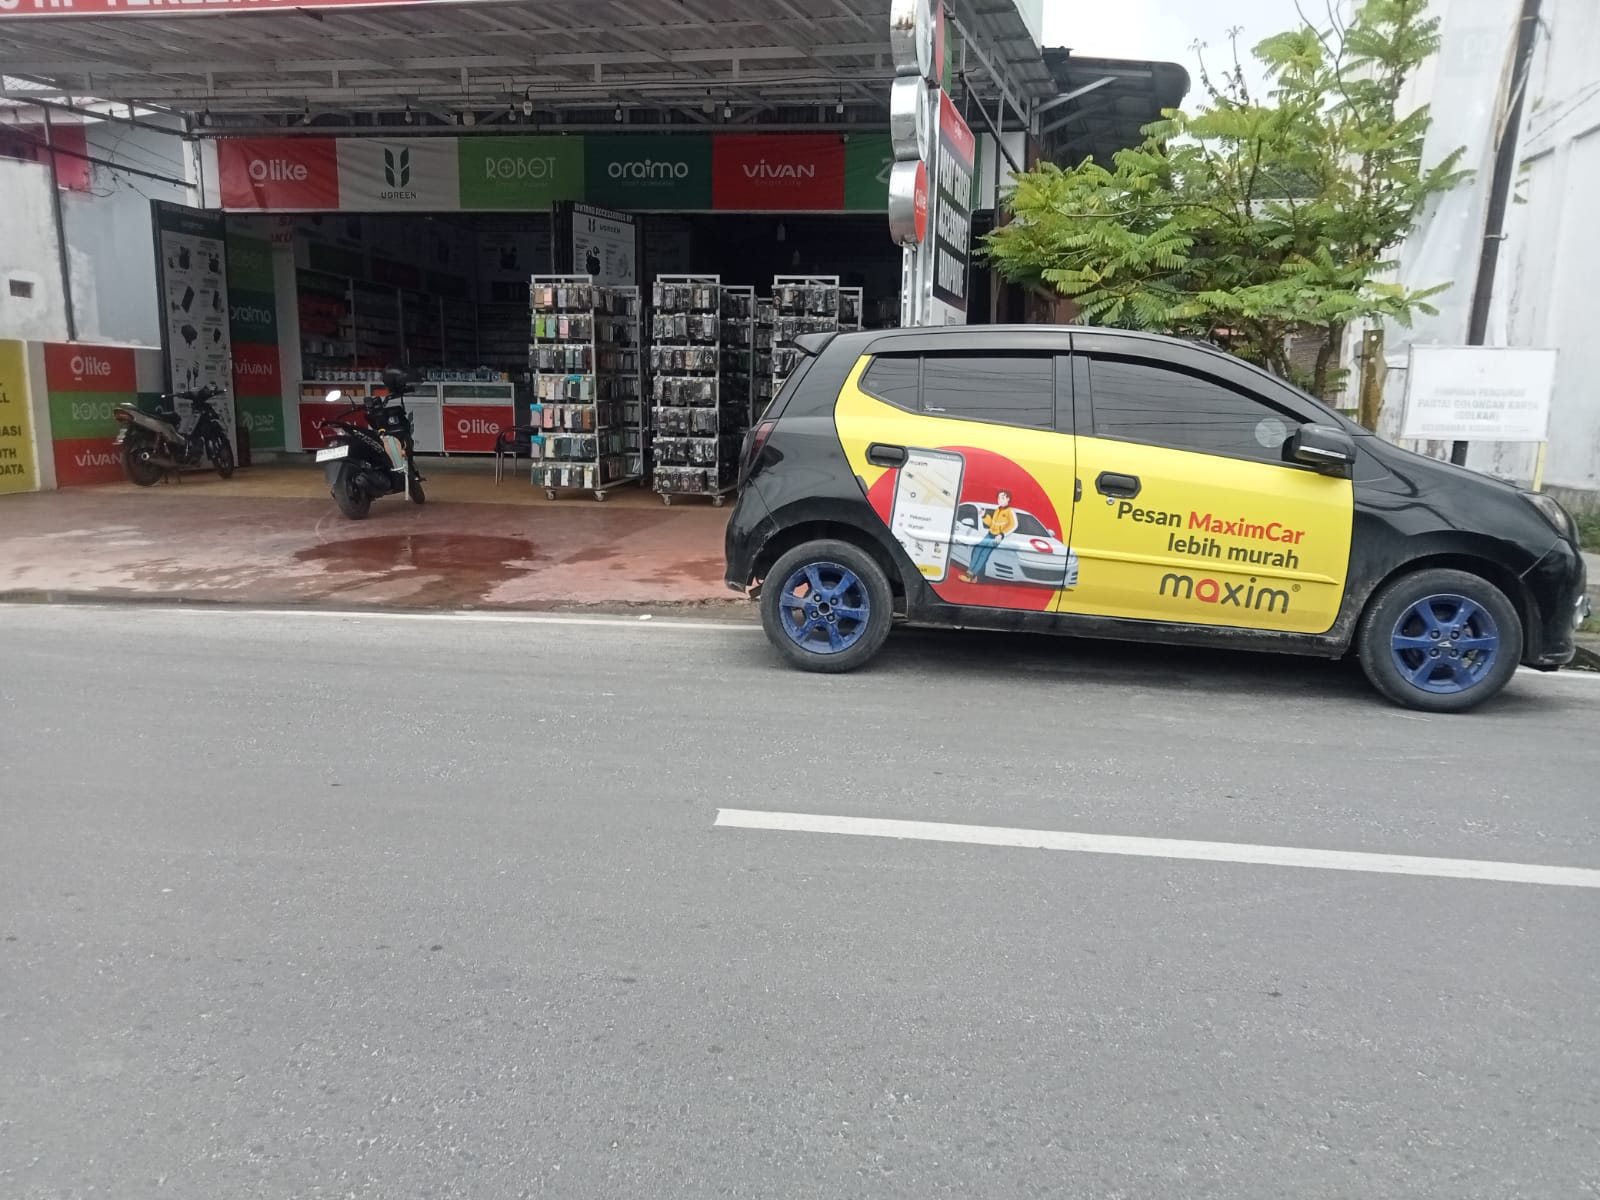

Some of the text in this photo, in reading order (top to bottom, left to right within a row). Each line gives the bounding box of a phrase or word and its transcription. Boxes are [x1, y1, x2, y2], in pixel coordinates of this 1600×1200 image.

[485, 157, 556, 179] ROBOT
[608, 159, 689, 178] oraimo
[381, 191, 417, 200] UGREEN
[72, 402, 117, 420] ROBO
[0, 424, 21, 437] ASI
[0, 447, 16, 459] TH
[1117, 501, 1305, 545] Pesan MaximCar
[1168, 533, 1299, 569] lebih murah
